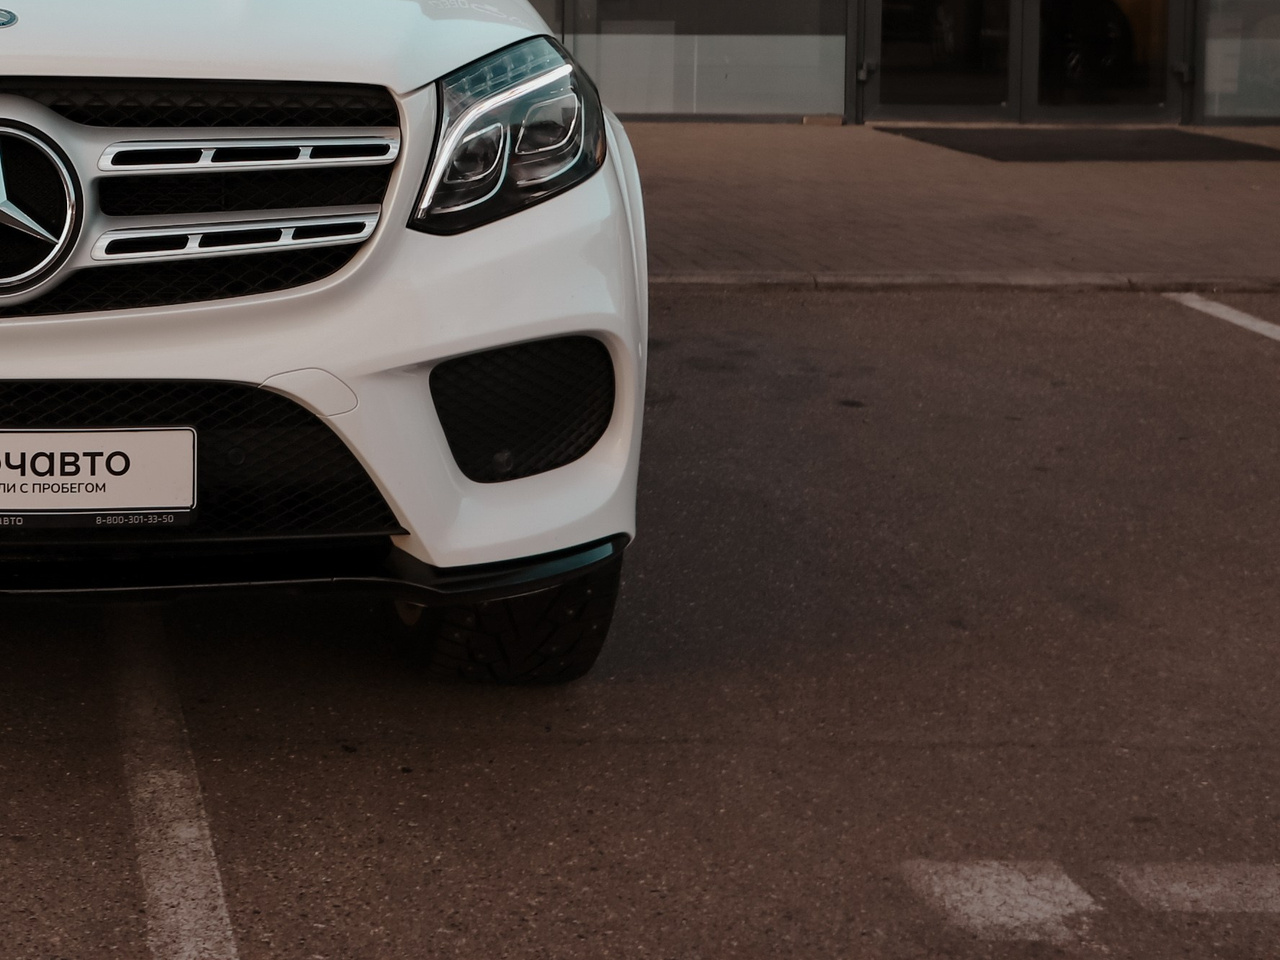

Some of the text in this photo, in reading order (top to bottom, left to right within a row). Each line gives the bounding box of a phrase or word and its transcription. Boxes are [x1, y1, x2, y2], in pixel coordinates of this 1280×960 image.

[19, 482, 29, 494] С
[32, 482, 107, 494] ПРОБЕГОМ
[95, 514, 175, 525] 8-800-301-33-50
